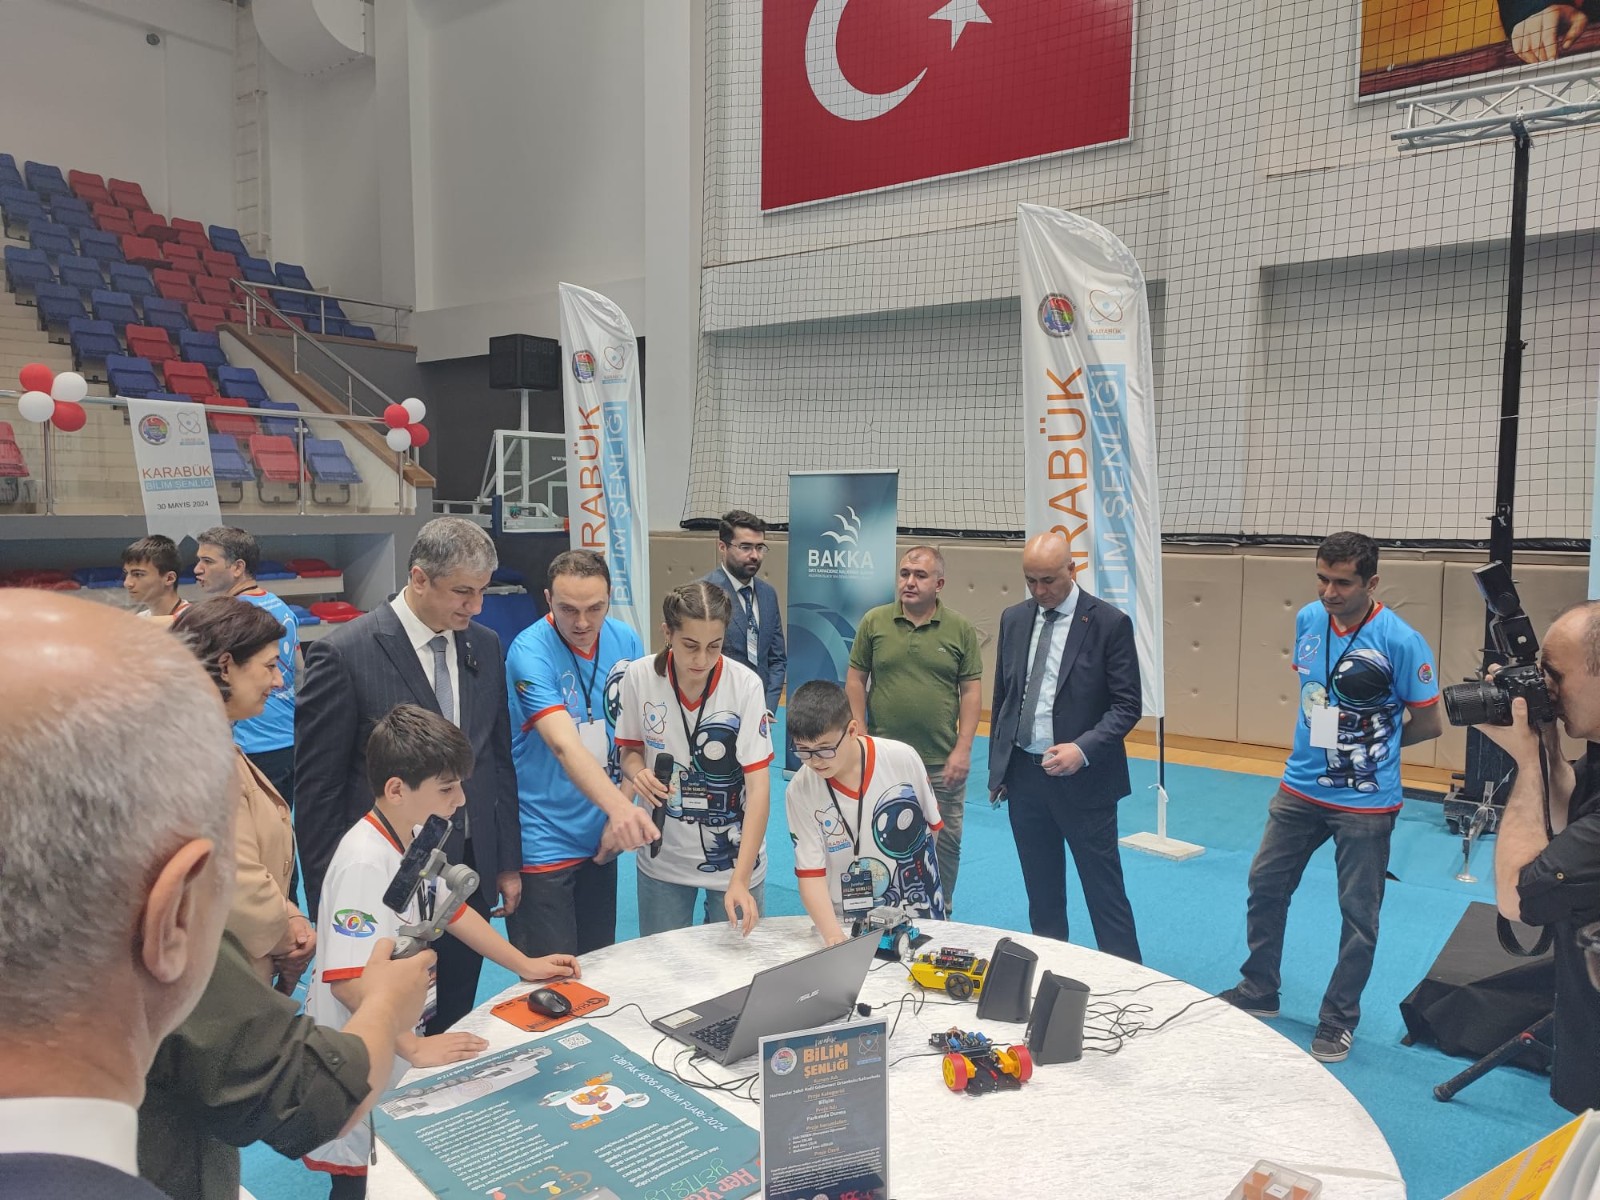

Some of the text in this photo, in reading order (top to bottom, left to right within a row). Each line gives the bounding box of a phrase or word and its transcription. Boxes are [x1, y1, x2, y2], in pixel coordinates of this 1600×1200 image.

[142, 464, 212, 479] KARABÜK
[574, 405, 606, 557] RABÜK
[1040, 367, 1089, 582] RABÜK
[808, 549, 874, 569] BAKKA
[1098, 532, 1129, 613] İLİM
[803, 1041, 848, 1063] BİLİM
[610, 1054, 640, 1075] TÜBİTAK
[637, 1072, 659, 1088] 4006
[804, 1058, 849, 1078] ŞENLİĞİ
[716, 1168, 759, 1192] Her
